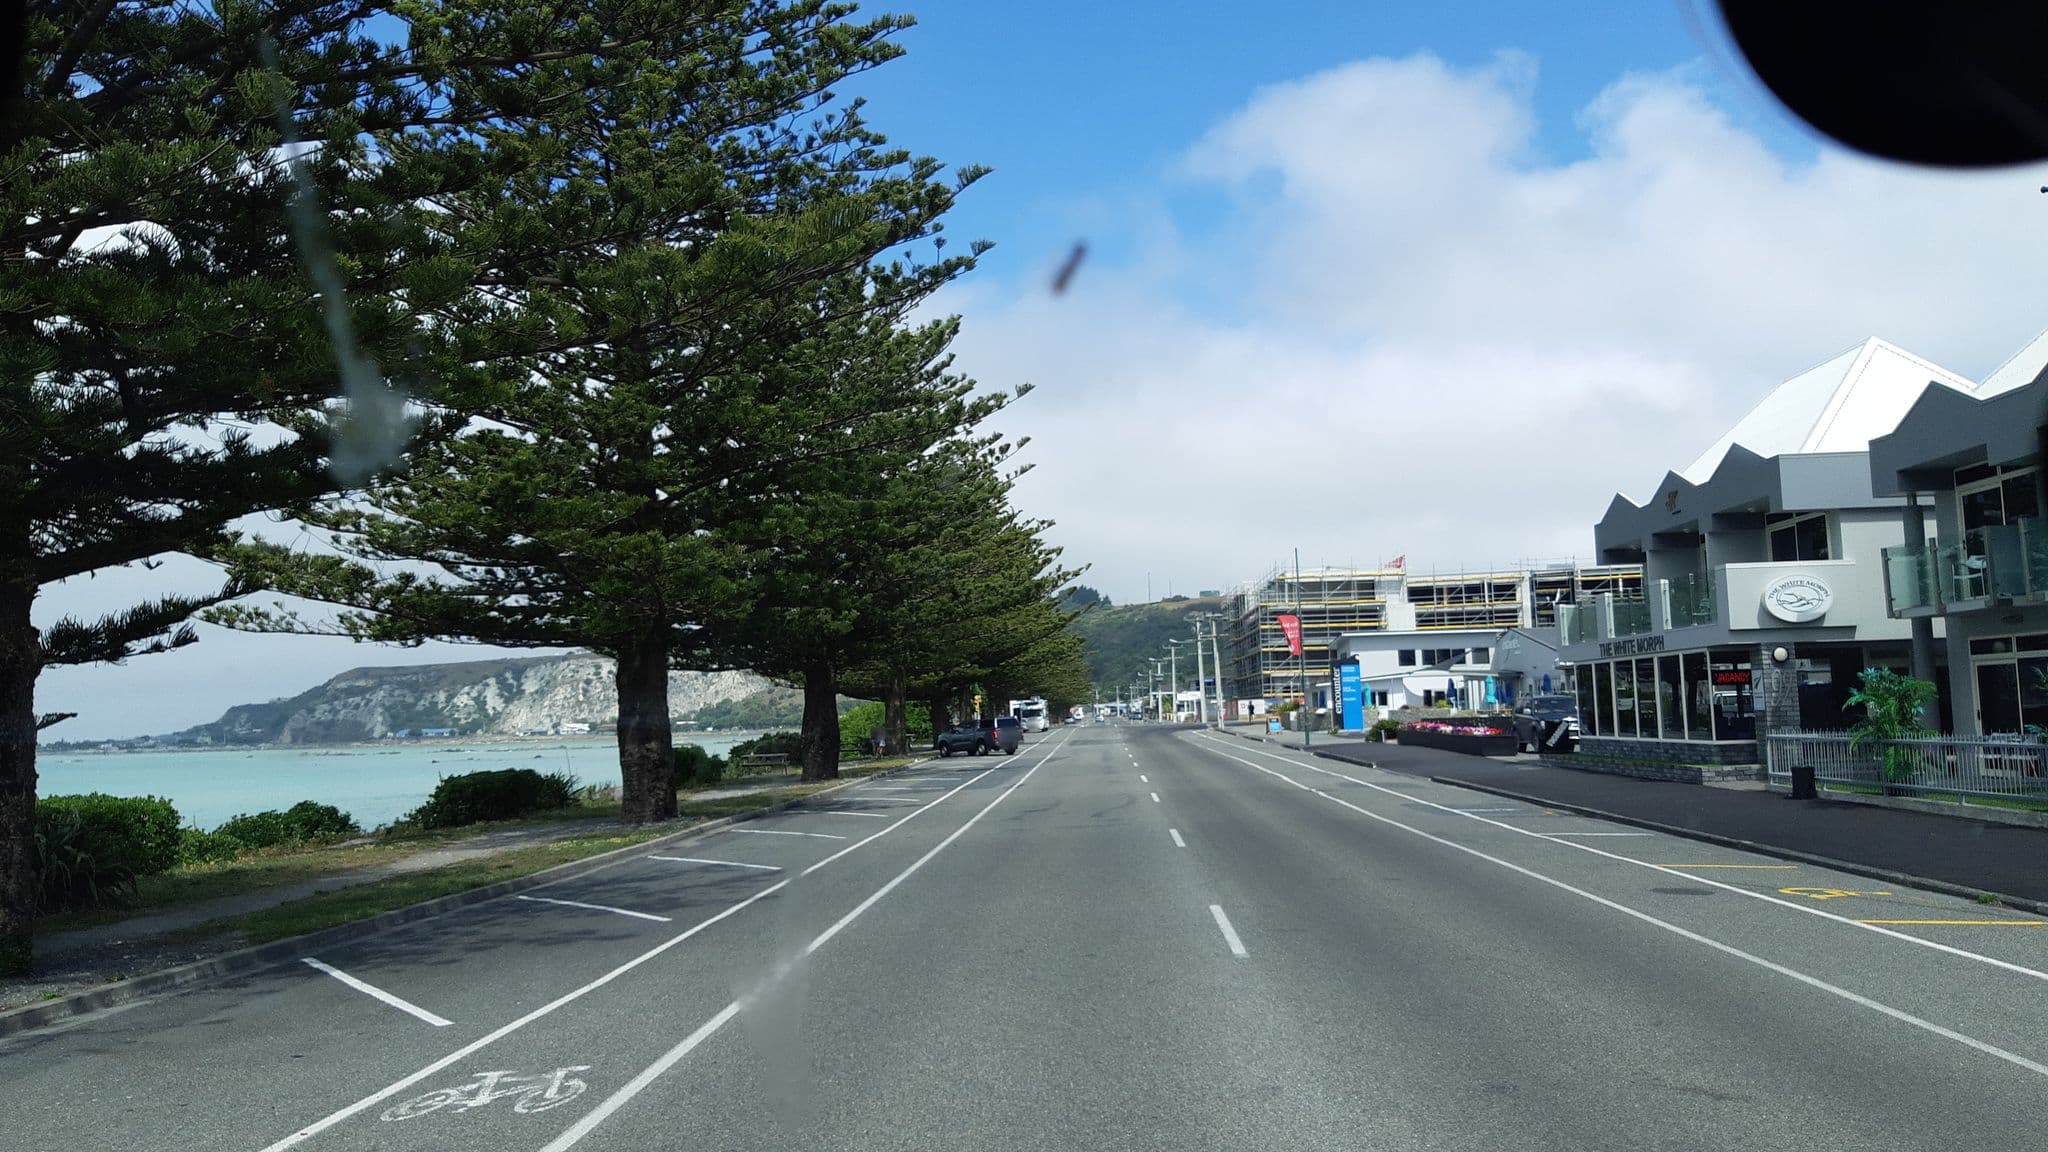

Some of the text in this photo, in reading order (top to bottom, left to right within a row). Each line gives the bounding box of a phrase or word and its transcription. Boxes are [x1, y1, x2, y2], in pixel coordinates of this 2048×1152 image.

[1768, 580, 1830, 599] THE WHITE MORPH
[1599, 635, 1665, 657] THE WHITE MORPH
[1714, 671, 1750, 682] VACANCY
[1333, 666, 1342, 715] encounter
